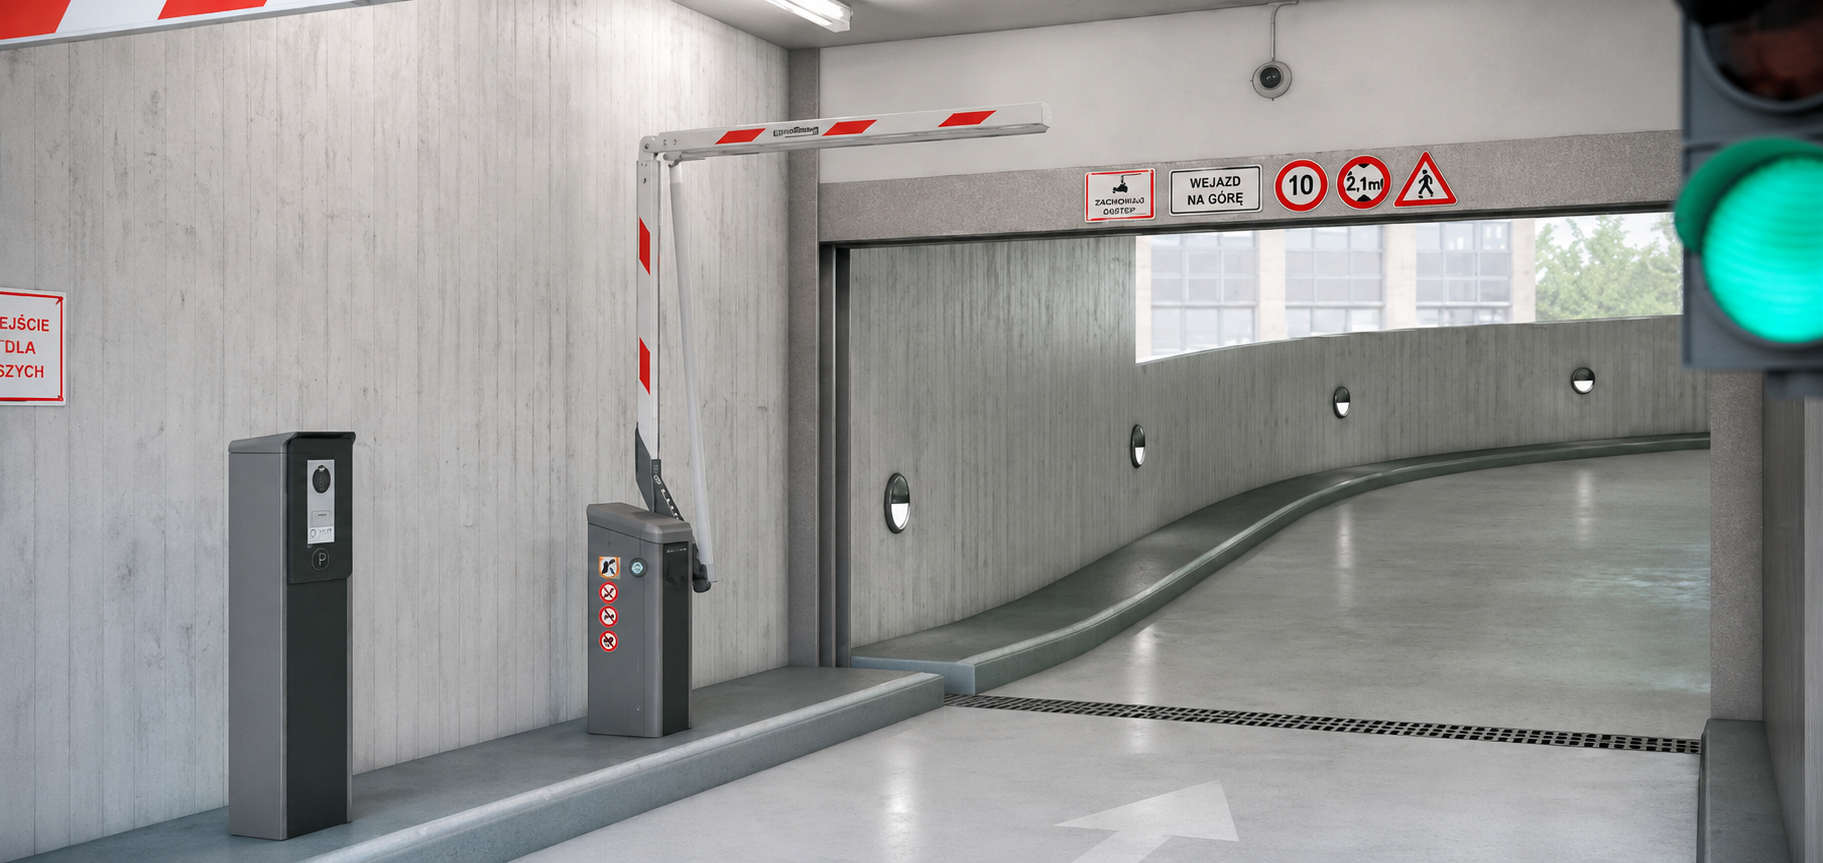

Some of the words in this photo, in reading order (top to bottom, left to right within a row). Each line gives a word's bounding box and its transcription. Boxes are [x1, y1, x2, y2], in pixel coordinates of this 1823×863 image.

[1190, 176, 1241, 188] WEJAZD
[1289, 174, 1313, 195] 10
[1187, 195, 1204, 205] NA
[1208, 190, 1243, 206] GÓRĘ
[5, 340, 36, 354] DLA
